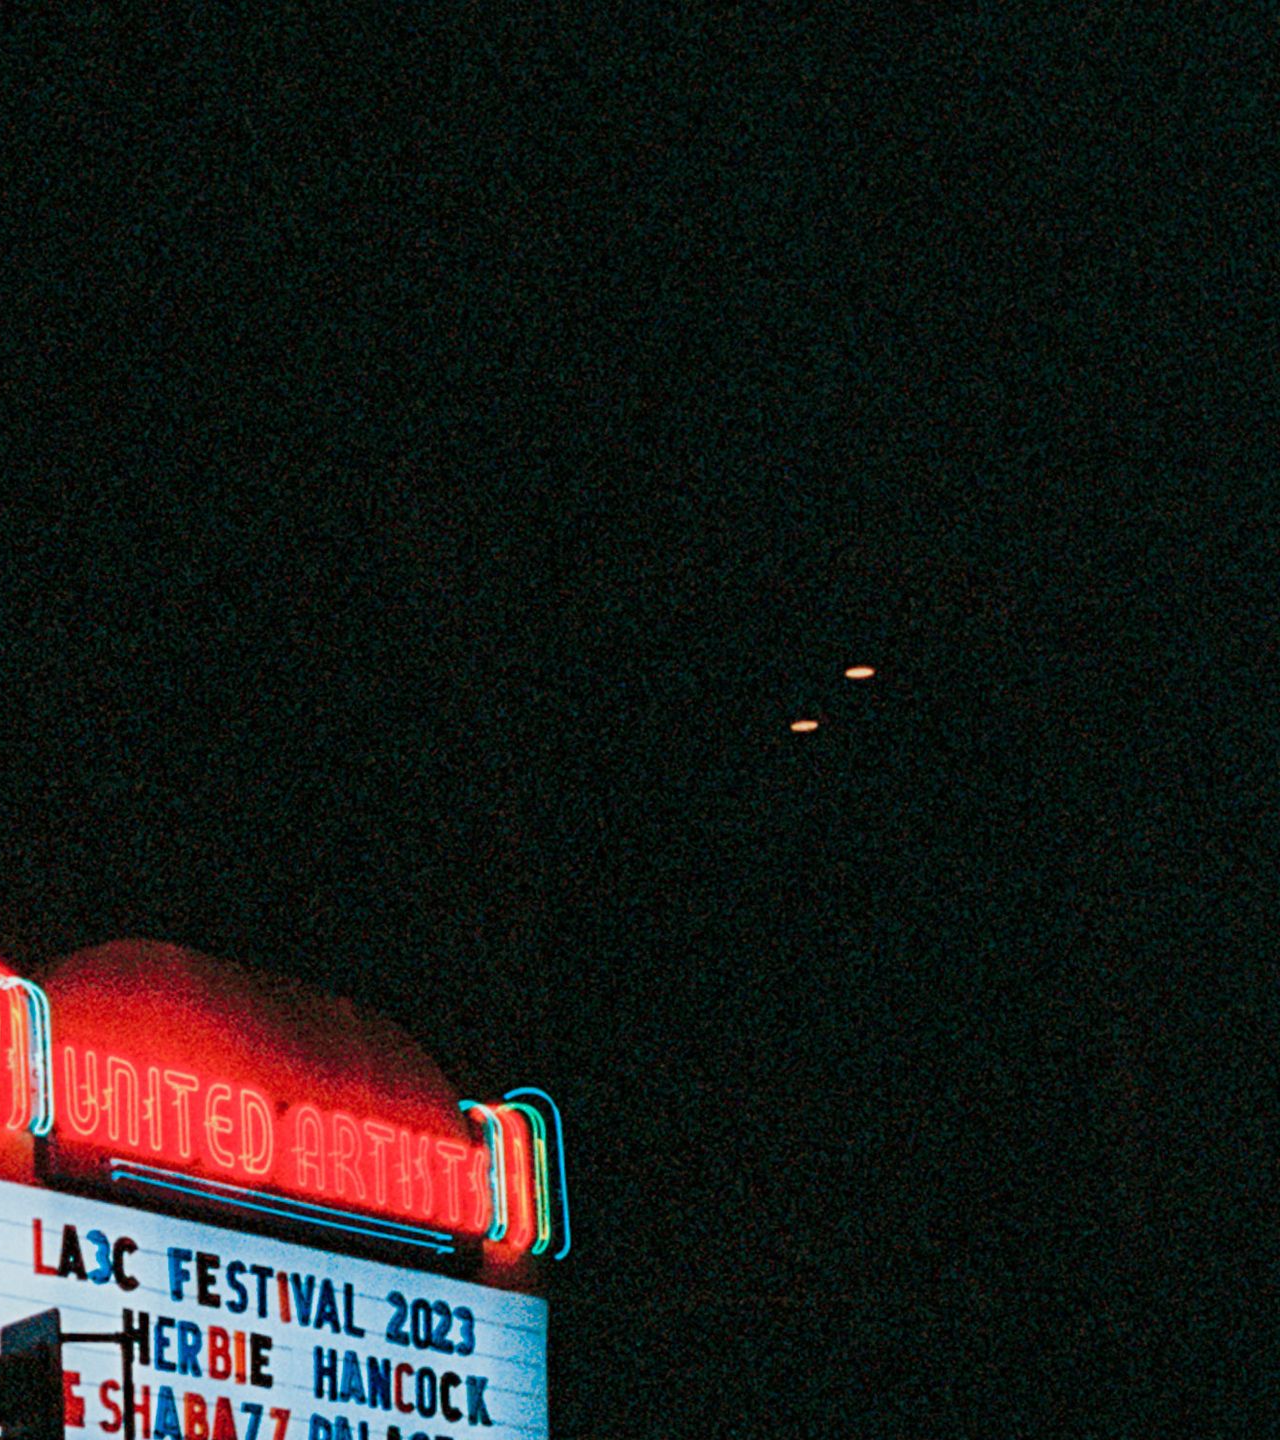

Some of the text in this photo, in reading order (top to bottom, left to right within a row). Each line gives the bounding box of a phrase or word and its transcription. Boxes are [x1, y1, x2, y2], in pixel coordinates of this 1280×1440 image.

[64, 1045, 489, 1230] UNITED ARTISTS
[33, 1218, 476, 1356] LA3C FESTIVAL 2023
[123, 1308, 493, 1427] HERBIE HANCOCK
